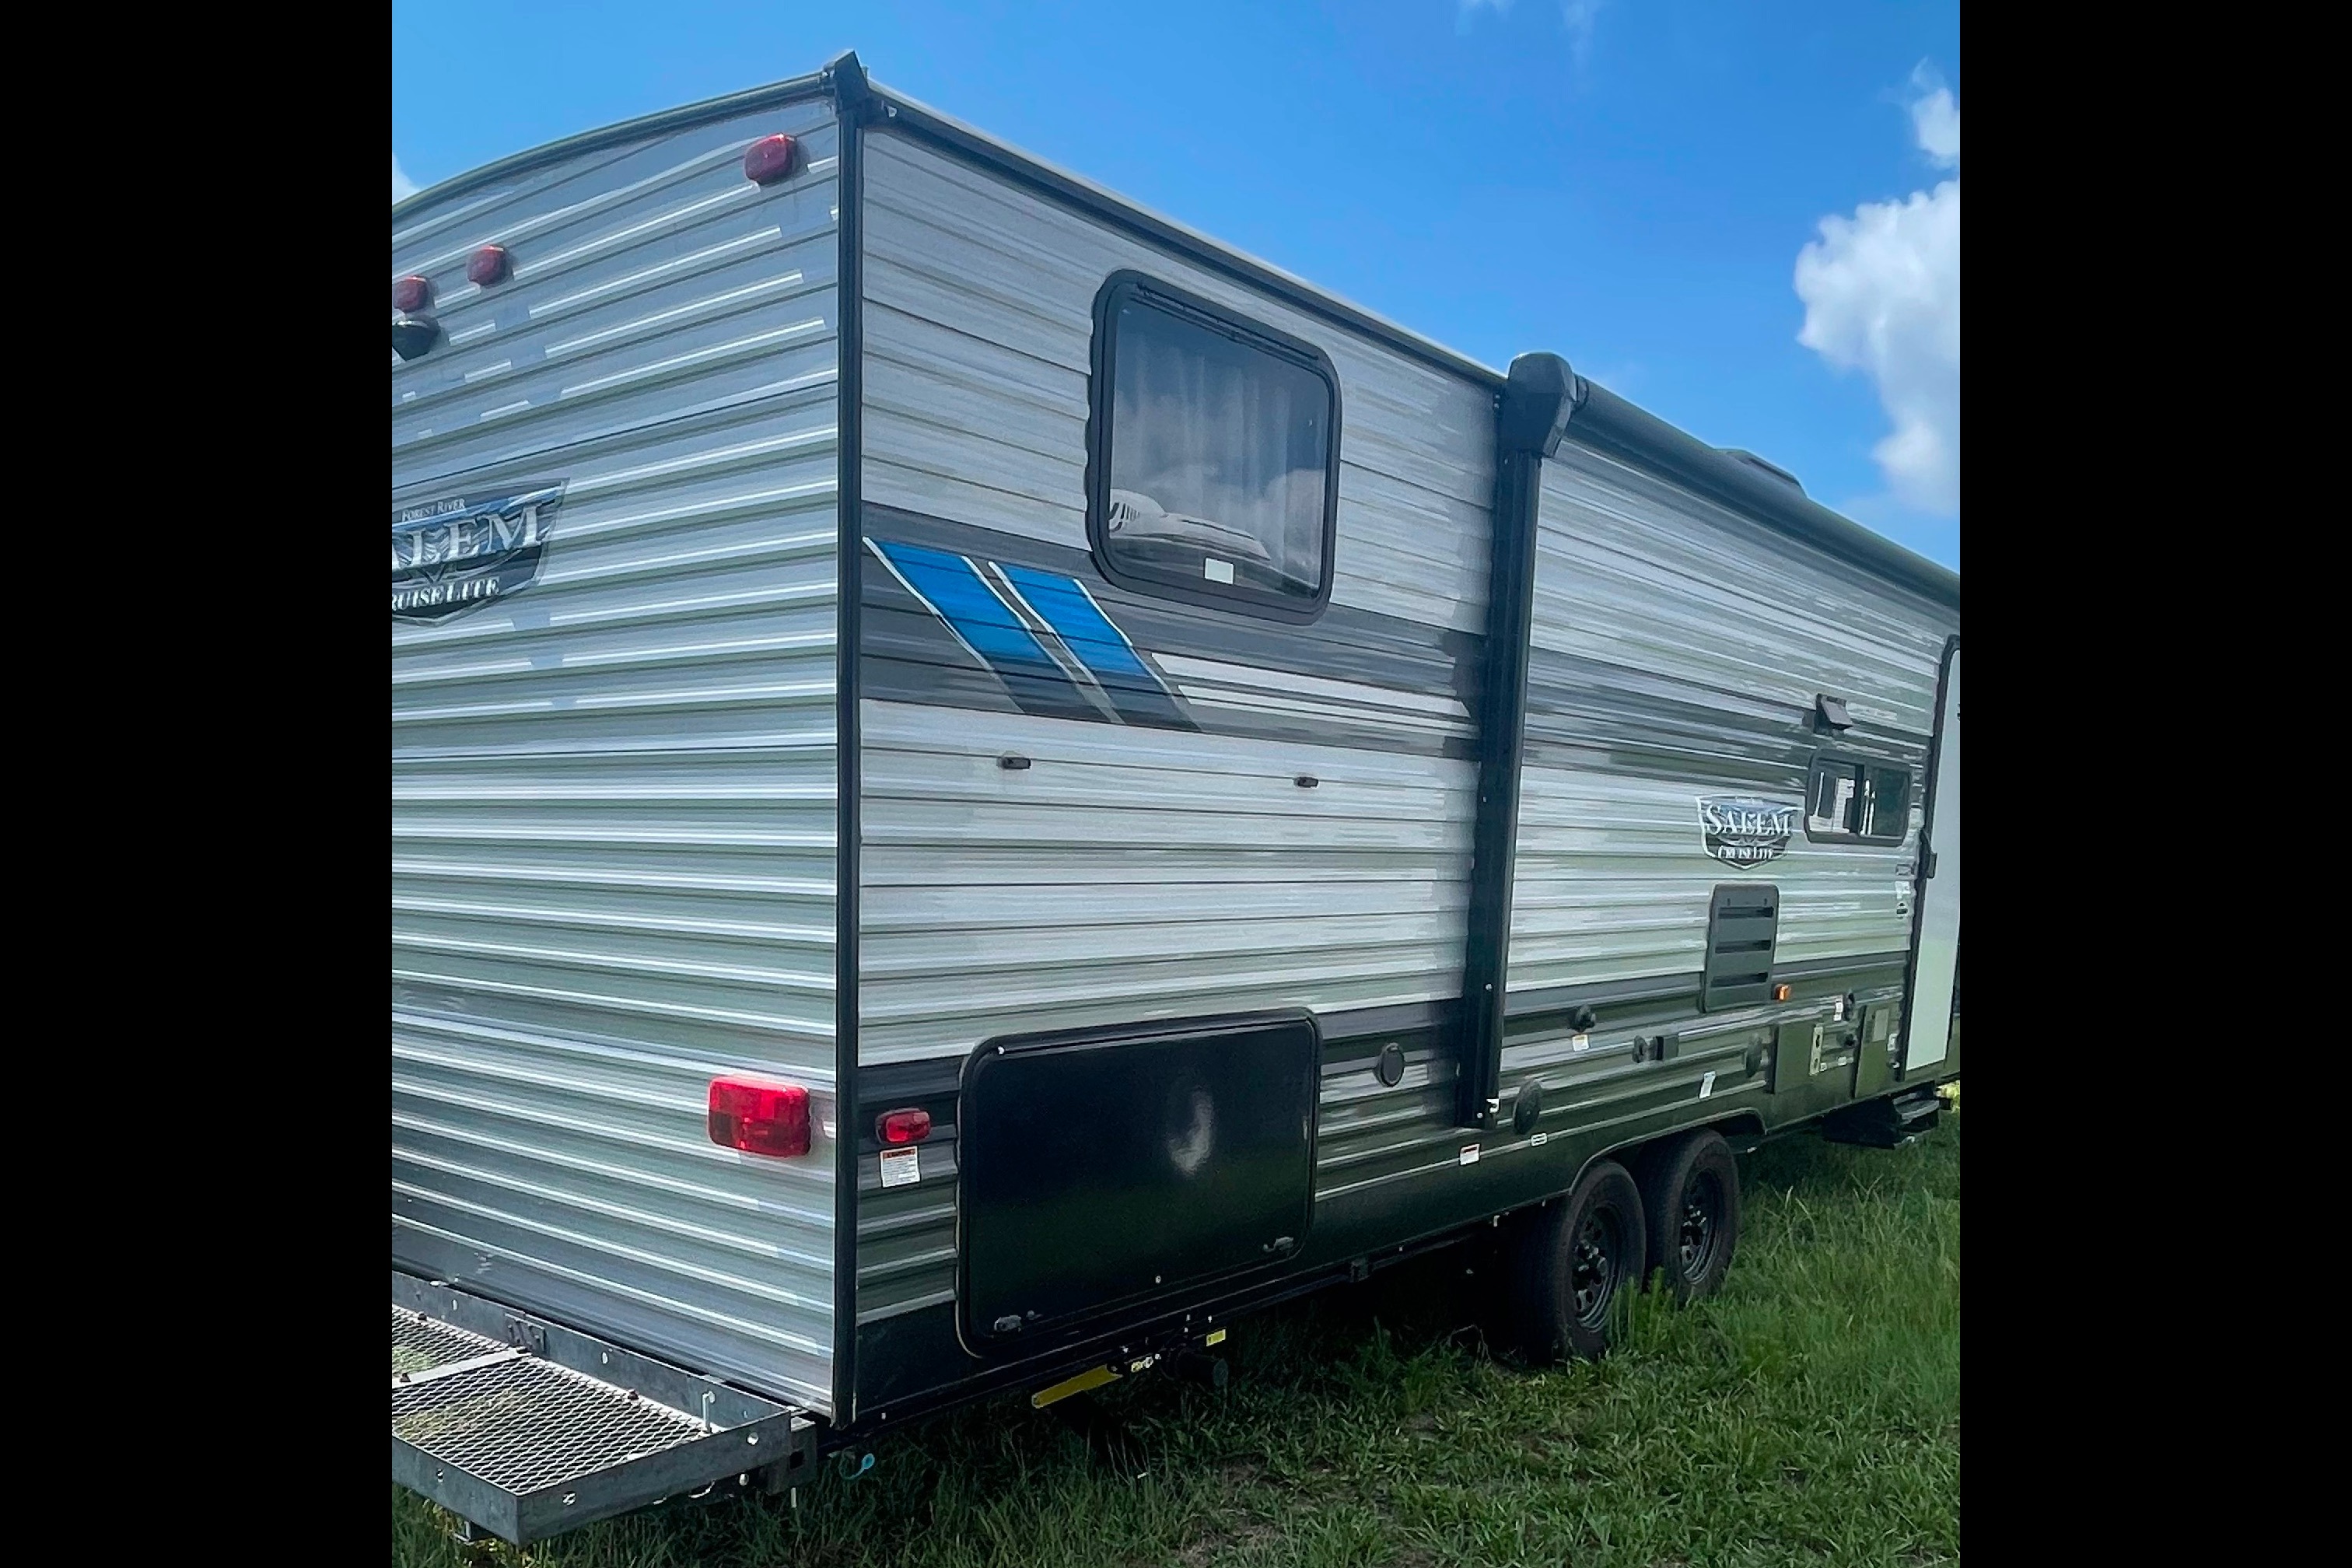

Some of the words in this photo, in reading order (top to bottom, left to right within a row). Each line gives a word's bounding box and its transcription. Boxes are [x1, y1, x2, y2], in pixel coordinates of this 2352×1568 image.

[401, 505, 436, 523] FOREST
[437, 498, 466, 514] RIVER
[1706, 804, 1790, 836] SALEM
